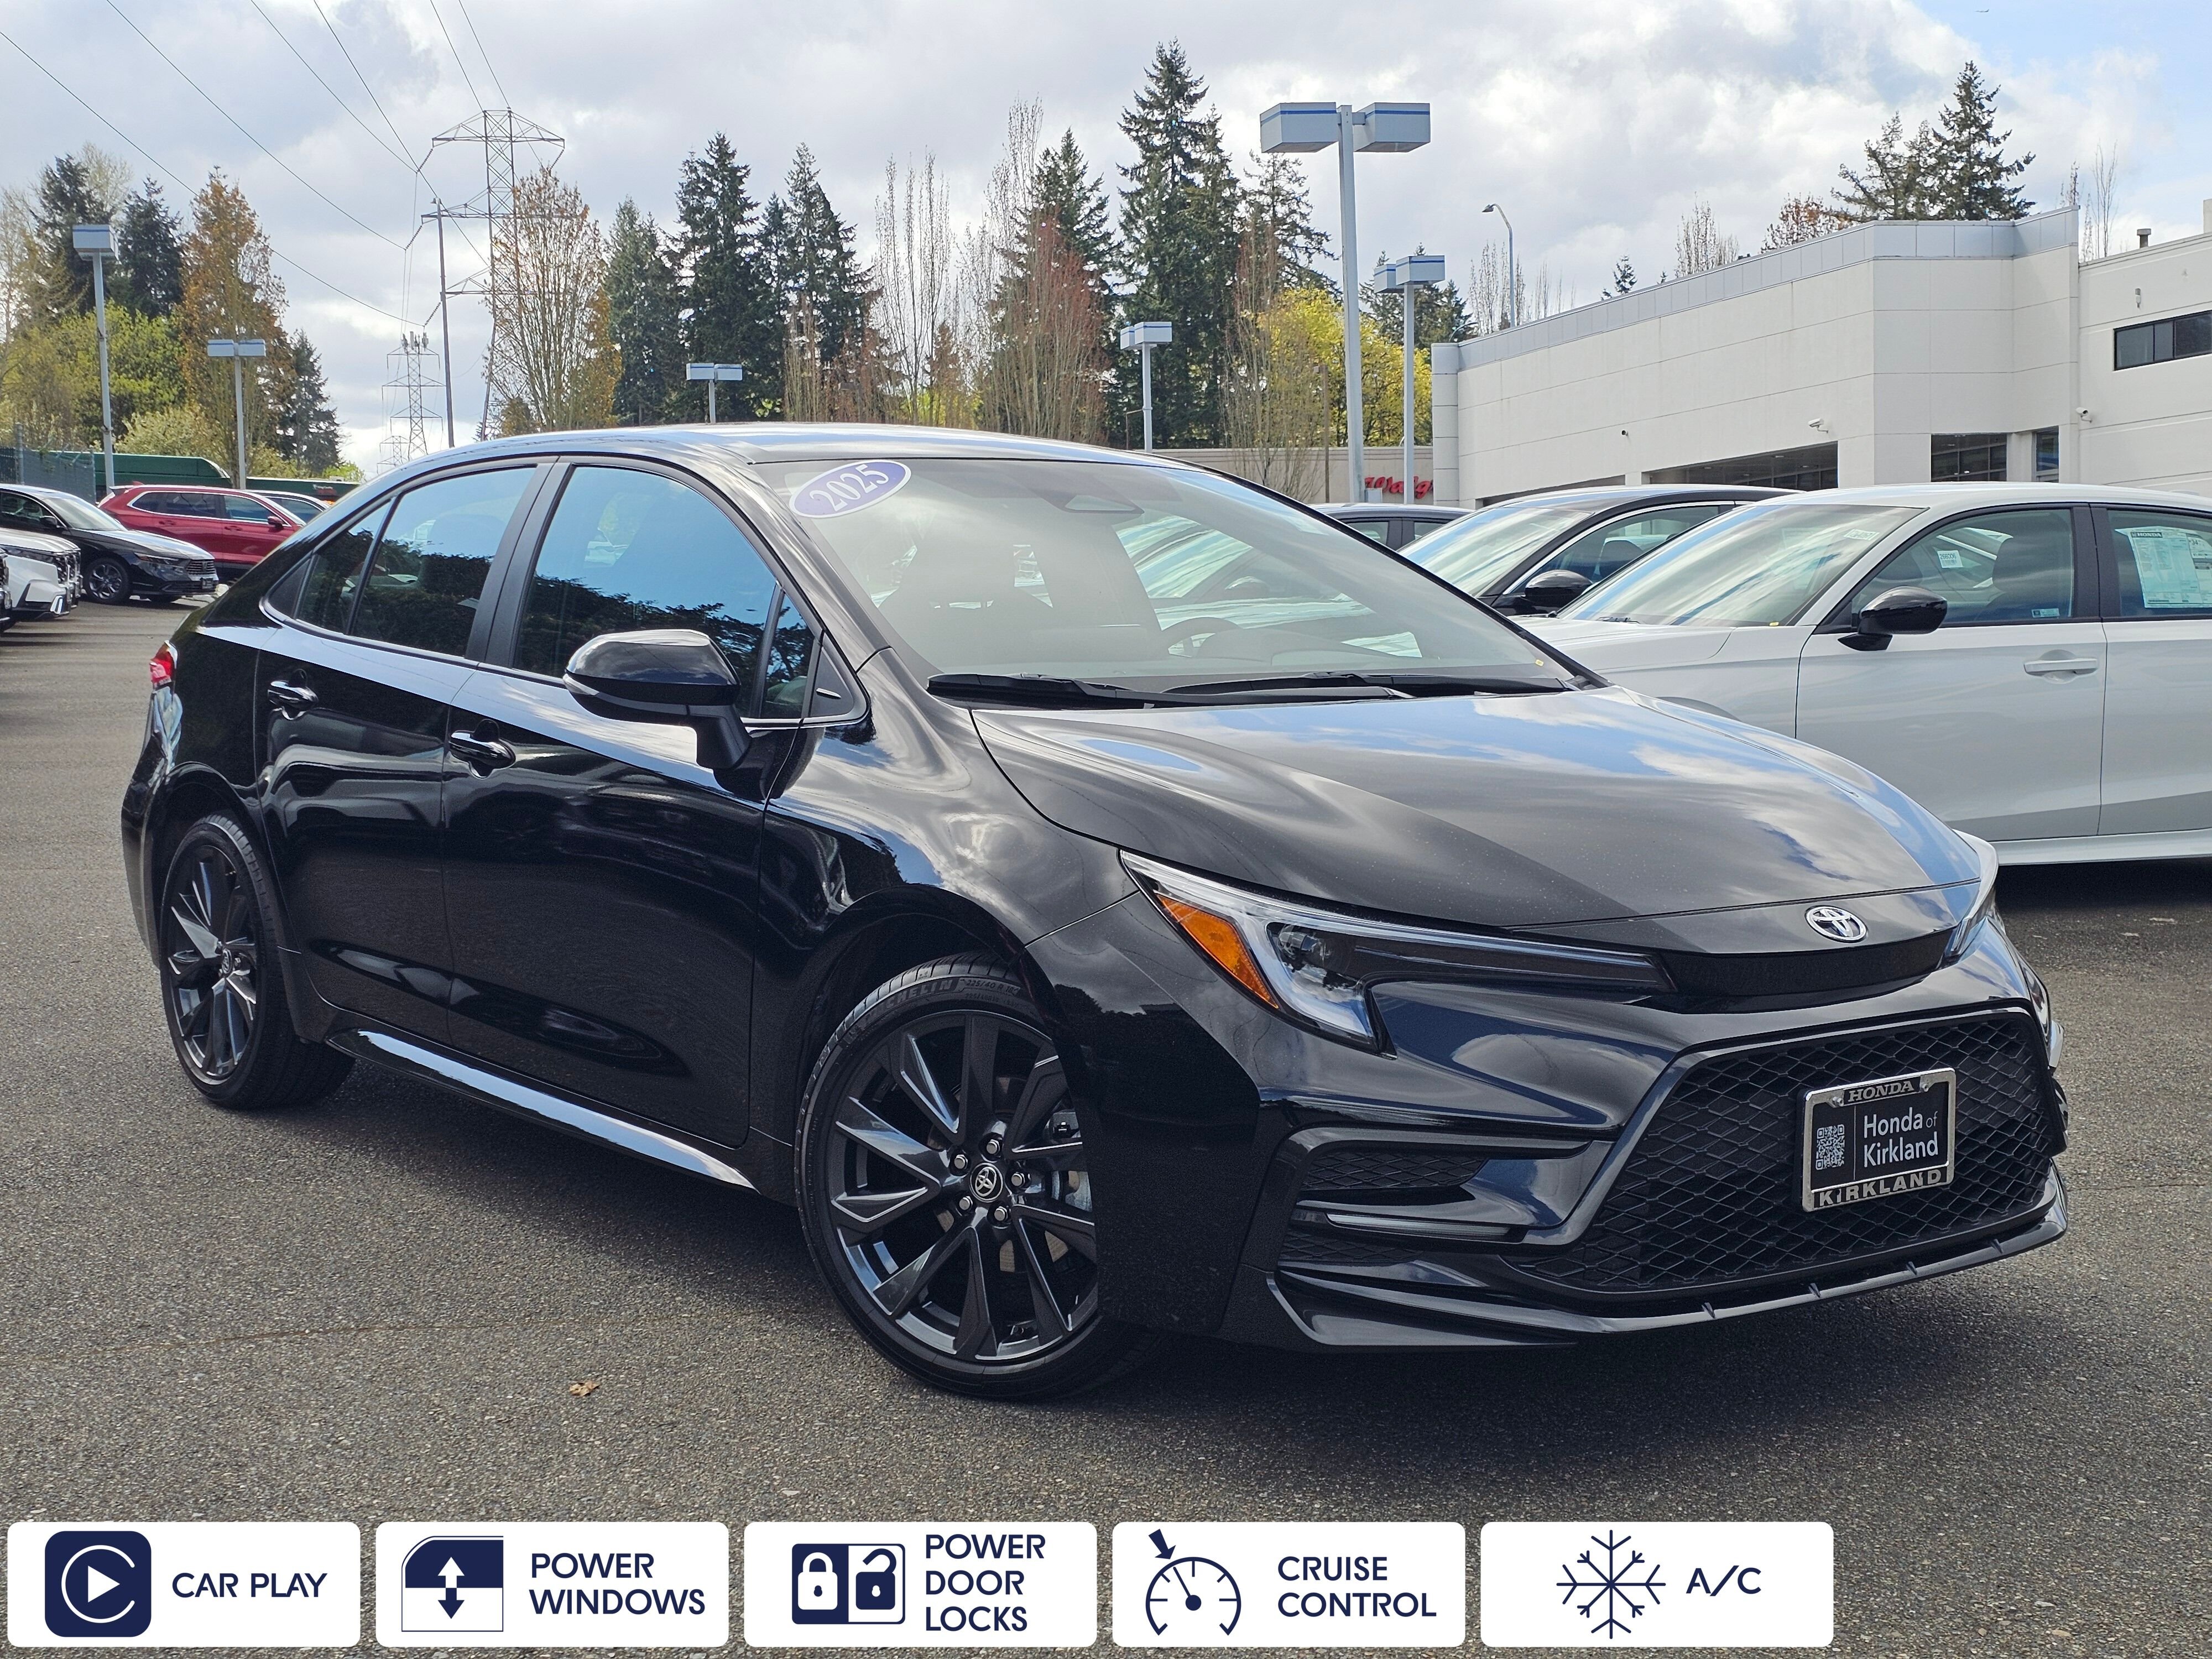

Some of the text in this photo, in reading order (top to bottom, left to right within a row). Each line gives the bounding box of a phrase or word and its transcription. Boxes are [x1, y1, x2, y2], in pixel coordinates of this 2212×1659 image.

[809, 464, 889, 512] 2025
[1848, 1081, 1914, 1103] HONDA
[1864, 1107, 1938, 1138] Honda of
[1864, 1131, 1938, 1167] Kirkland
[1819, 1169, 1942, 1207] KIRKLAND
